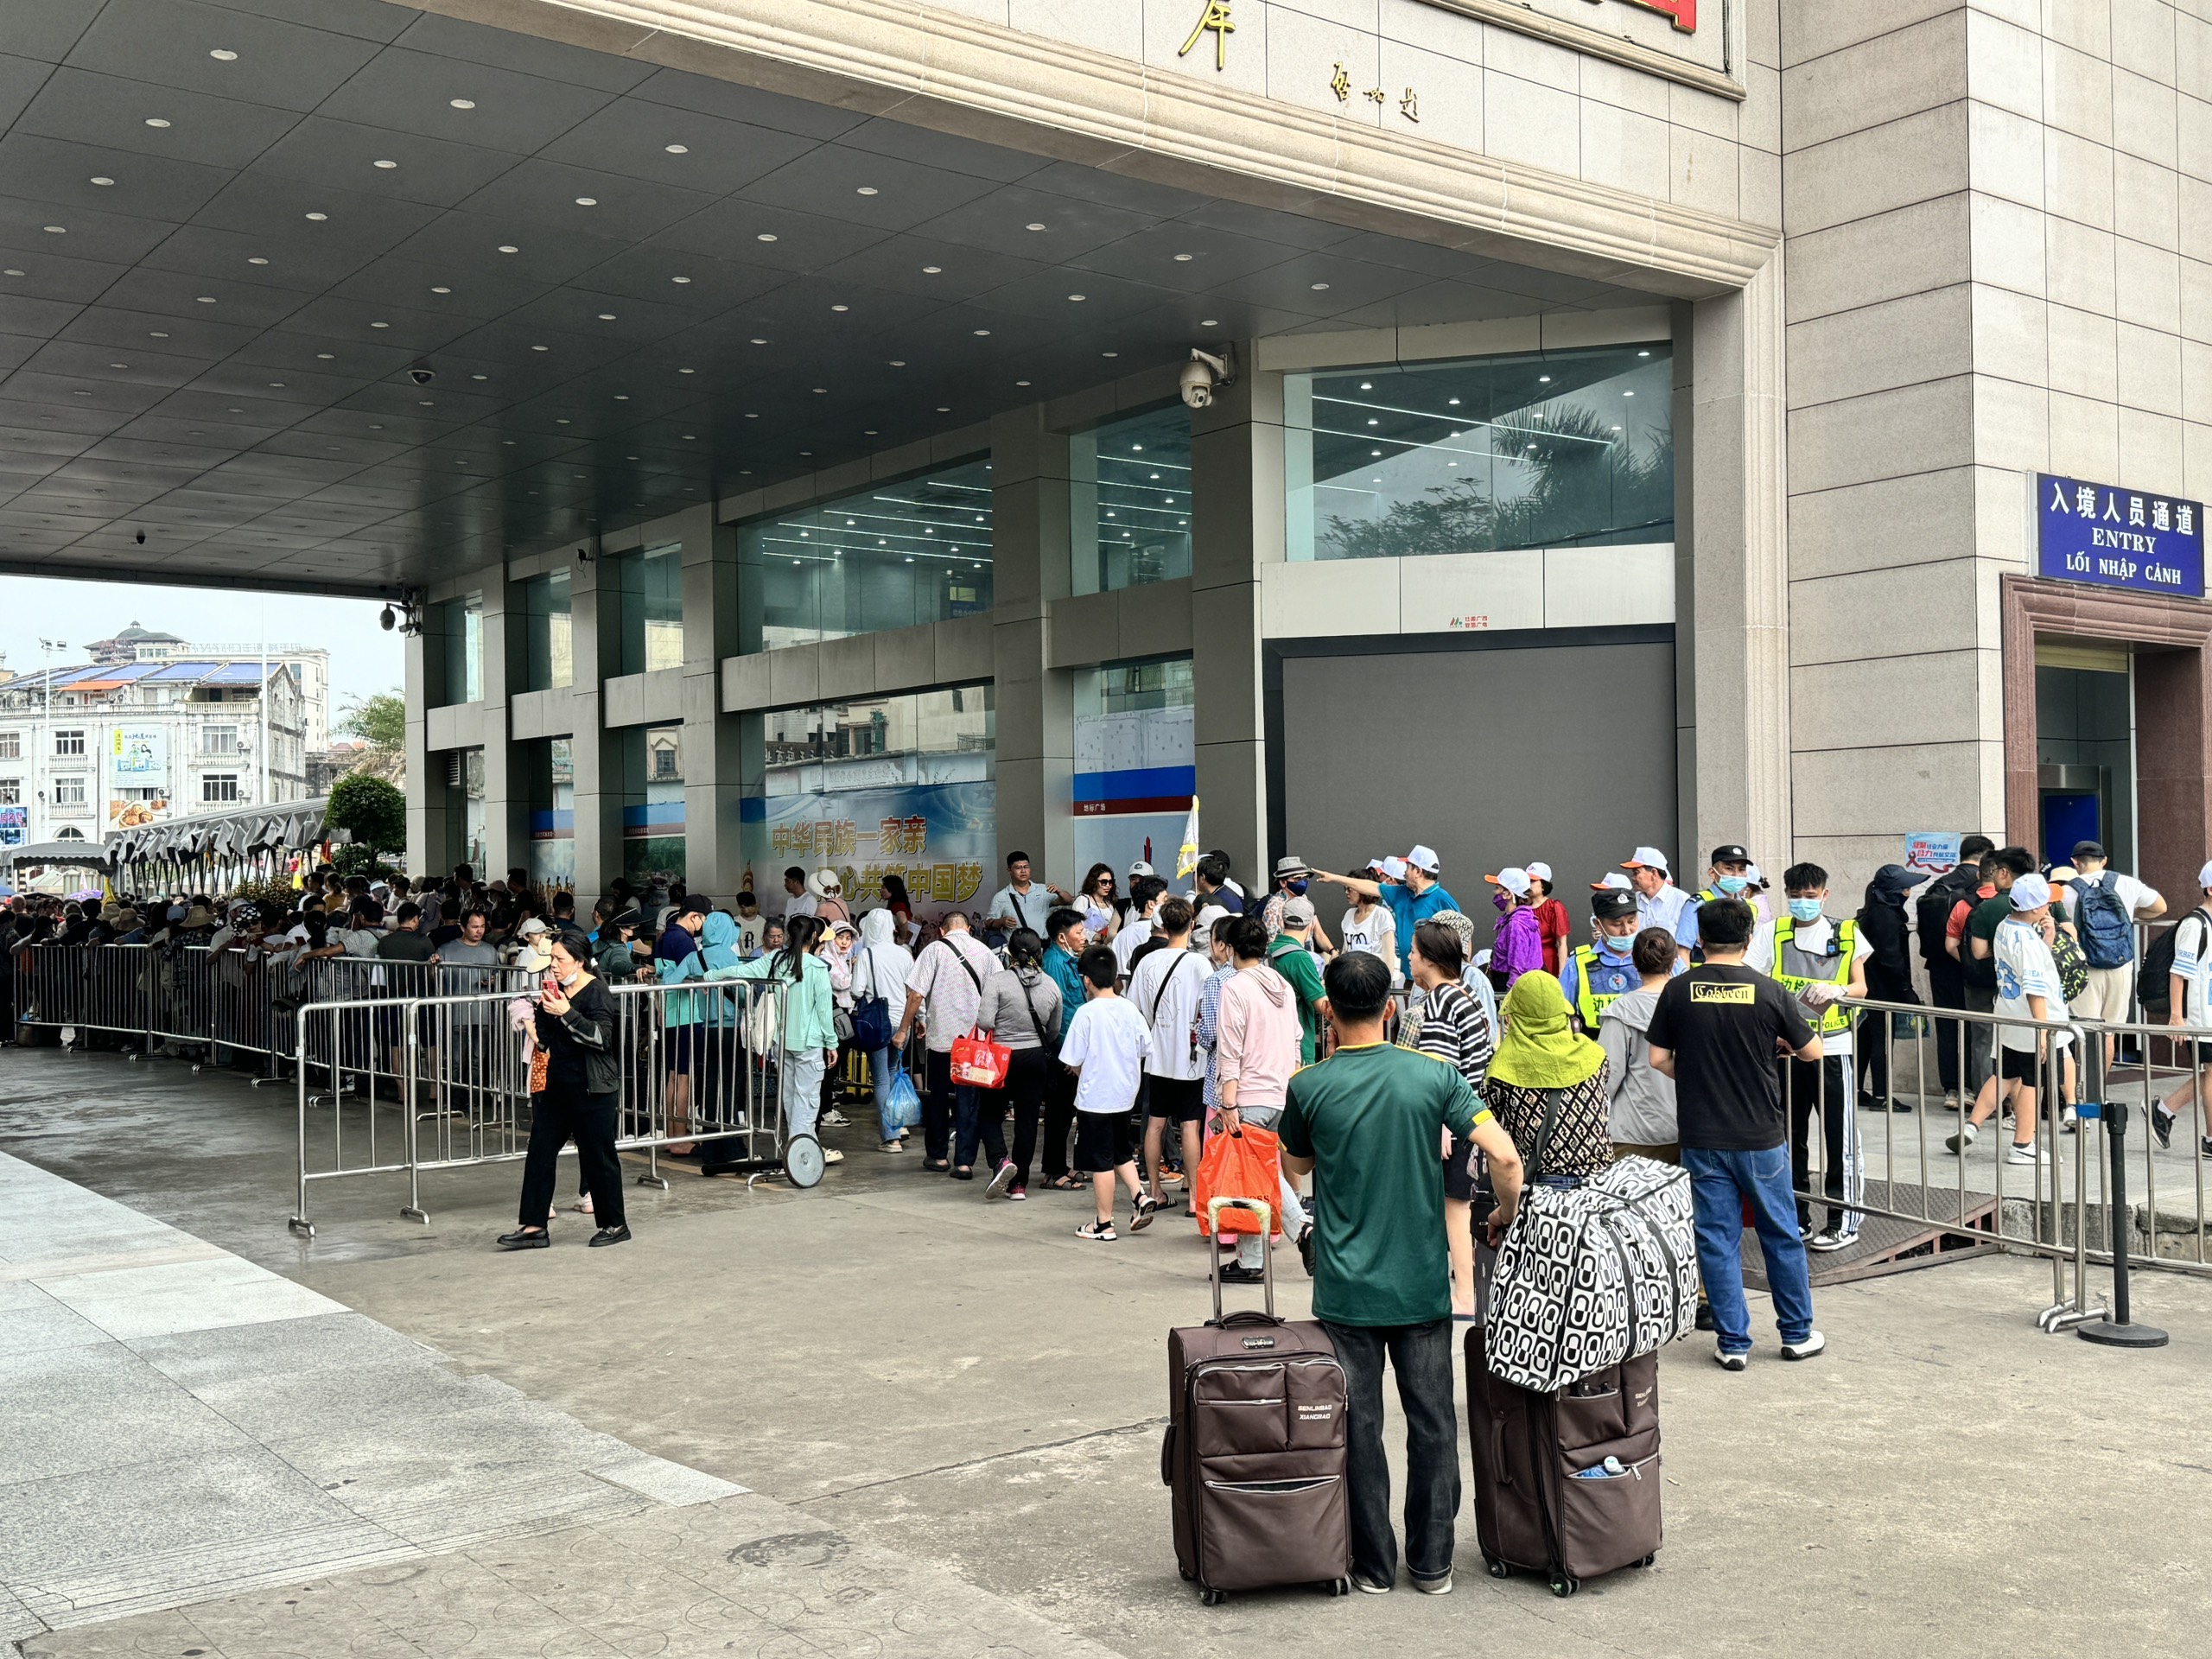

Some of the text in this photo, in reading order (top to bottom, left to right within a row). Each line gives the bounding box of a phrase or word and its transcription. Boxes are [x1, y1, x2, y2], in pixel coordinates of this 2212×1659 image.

[2050, 482, 2194, 536] 入境人员通道
[2092, 527, 2157, 554] ENTRY
[2066, 551, 2182, 585] LỐI NHẬP CẢNH
[772, 815, 927, 858] 中华民族一家亲
[817, 861, 982, 903] 心共中国梦
[1695, 985, 1748, 999] Cabbeen
